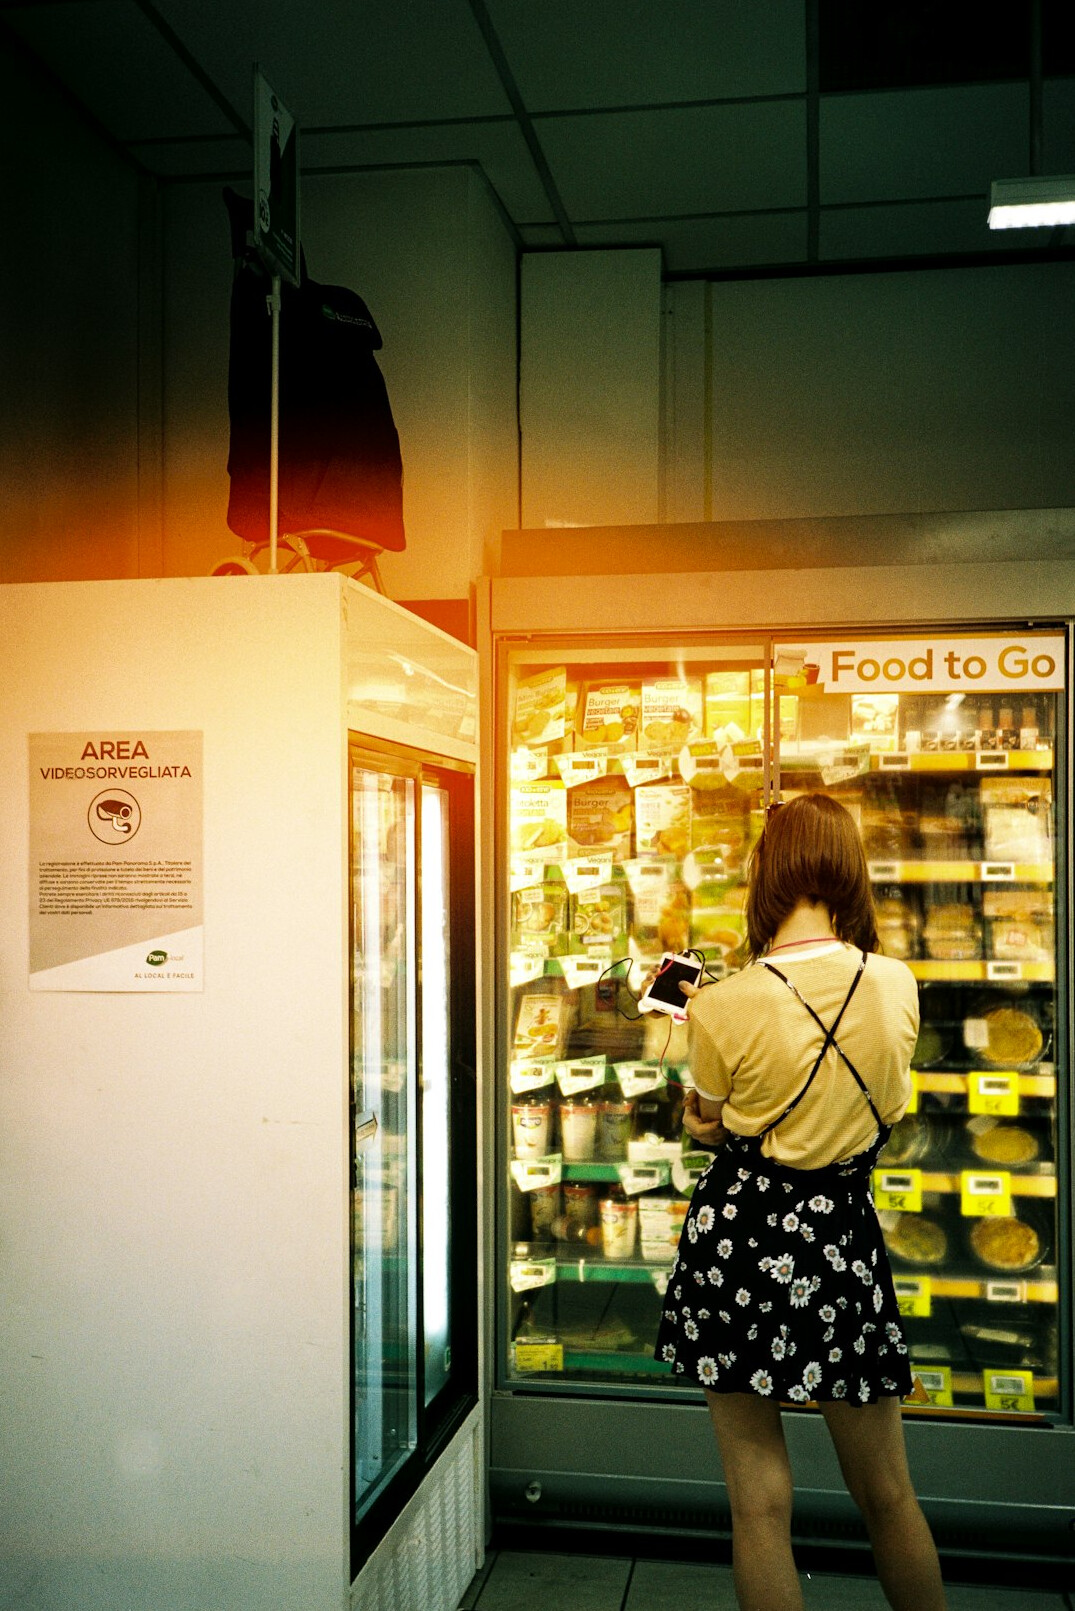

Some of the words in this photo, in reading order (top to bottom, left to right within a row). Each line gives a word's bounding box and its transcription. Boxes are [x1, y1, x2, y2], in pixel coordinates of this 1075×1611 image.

[832, 649, 933, 683] Food
[944, 651, 987, 680] to
[998, 646, 1056, 679] Go
[588, 697, 620, 707] Burger
[644, 694, 678, 704] Burger
[81, 741, 150, 760] AREA
[40, 766, 192, 780] VIDEOSORVEGLIATA
[573, 798, 610, 809] Burger
[148, 954, 165, 962] Pam
[888, 1195, 906, 1209] 5€
[1000, 1396, 1018, 1410] 5€
